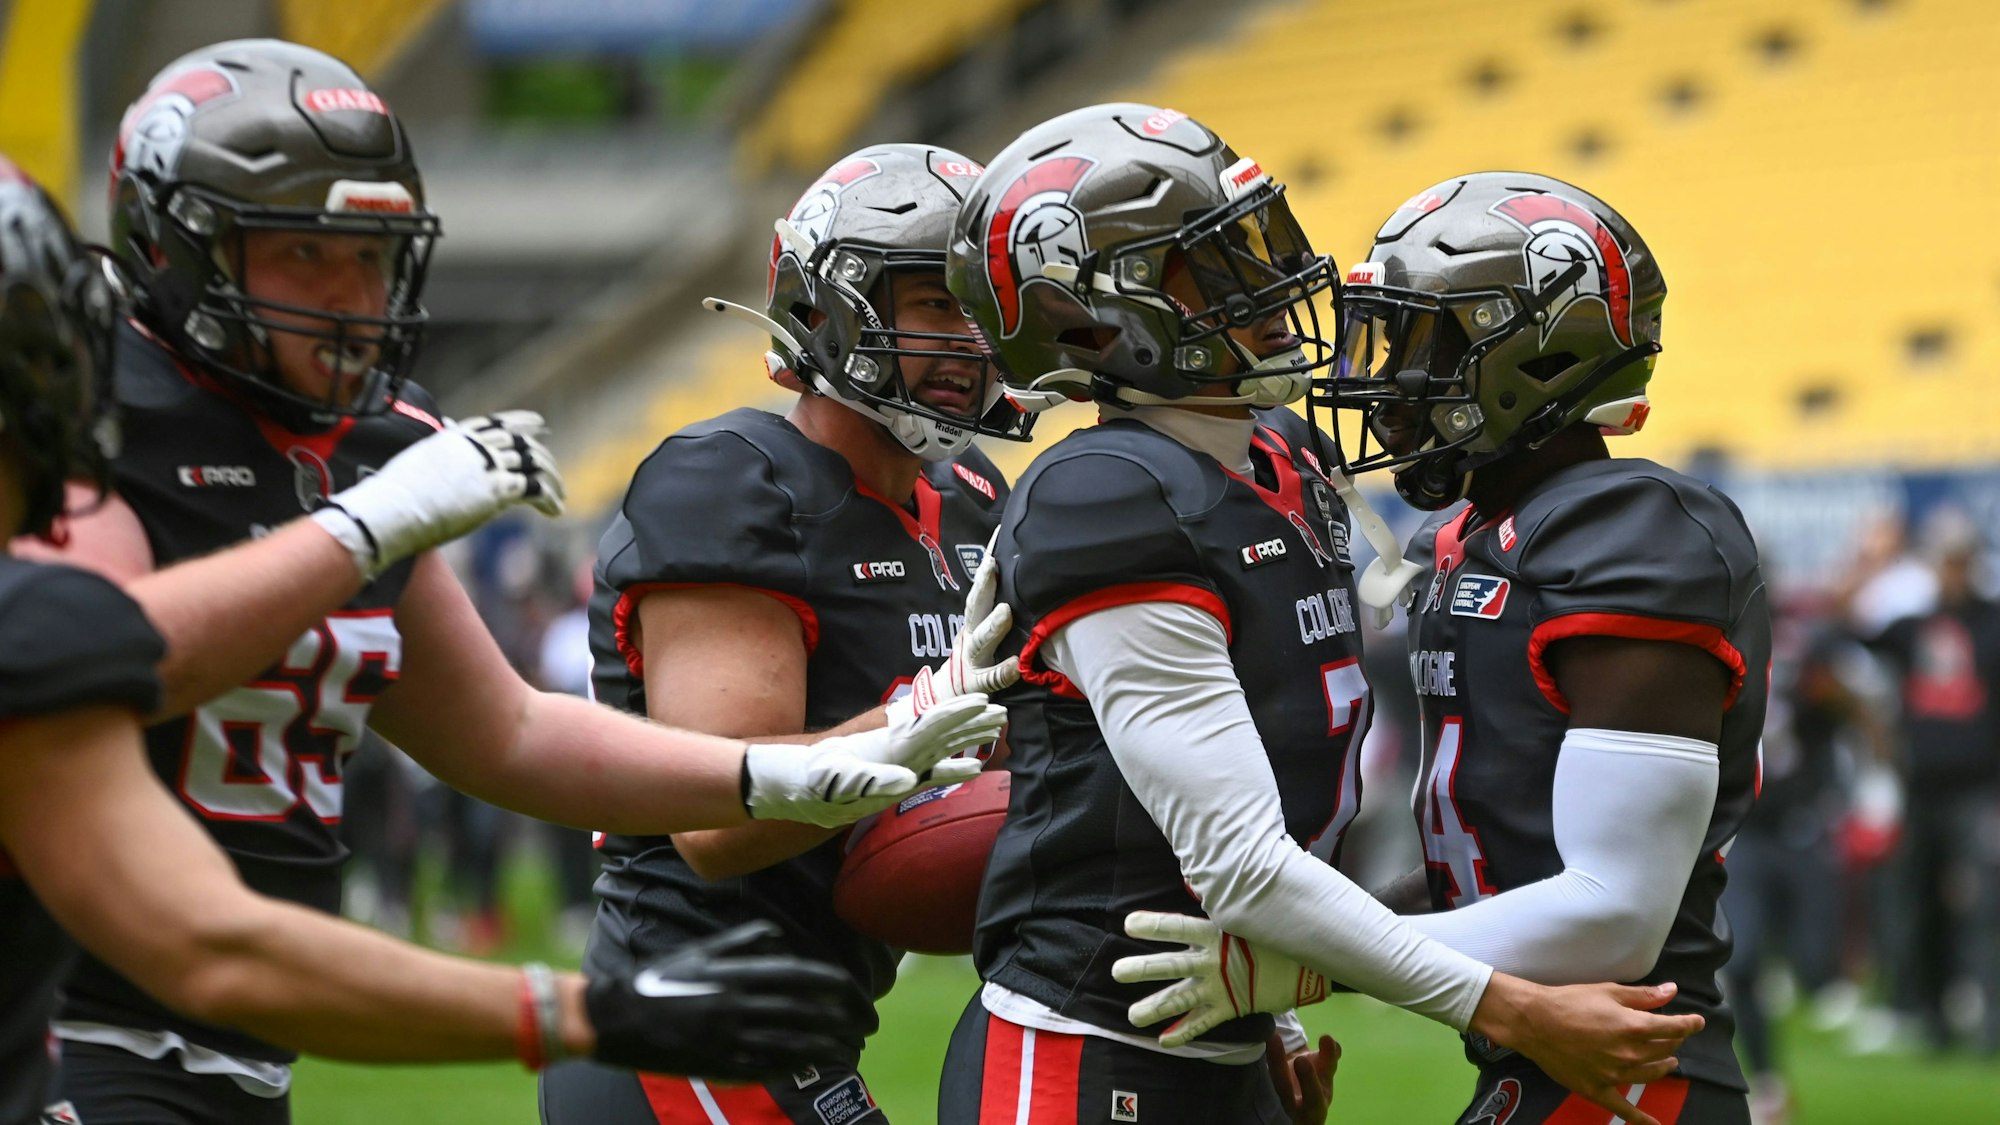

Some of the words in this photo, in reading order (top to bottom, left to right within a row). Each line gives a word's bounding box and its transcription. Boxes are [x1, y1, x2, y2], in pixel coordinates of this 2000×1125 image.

[945, 162, 986, 177] GA
[934, 420, 963, 439] Riddell
[957, 463, 994, 499] GAZI
[1295, 587, 1357, 645] COLOGNE
[907, 613, 968, 658] COLO
[177, 608, 403, 825] 65
[1307, 655, 1374, 868] 7
[819, 1087, 852, 1112] EUROPEAN
[825, 1102, 850, 1119] LEAGUE
[830, 1104, 861, 1125] FOOTBALL
